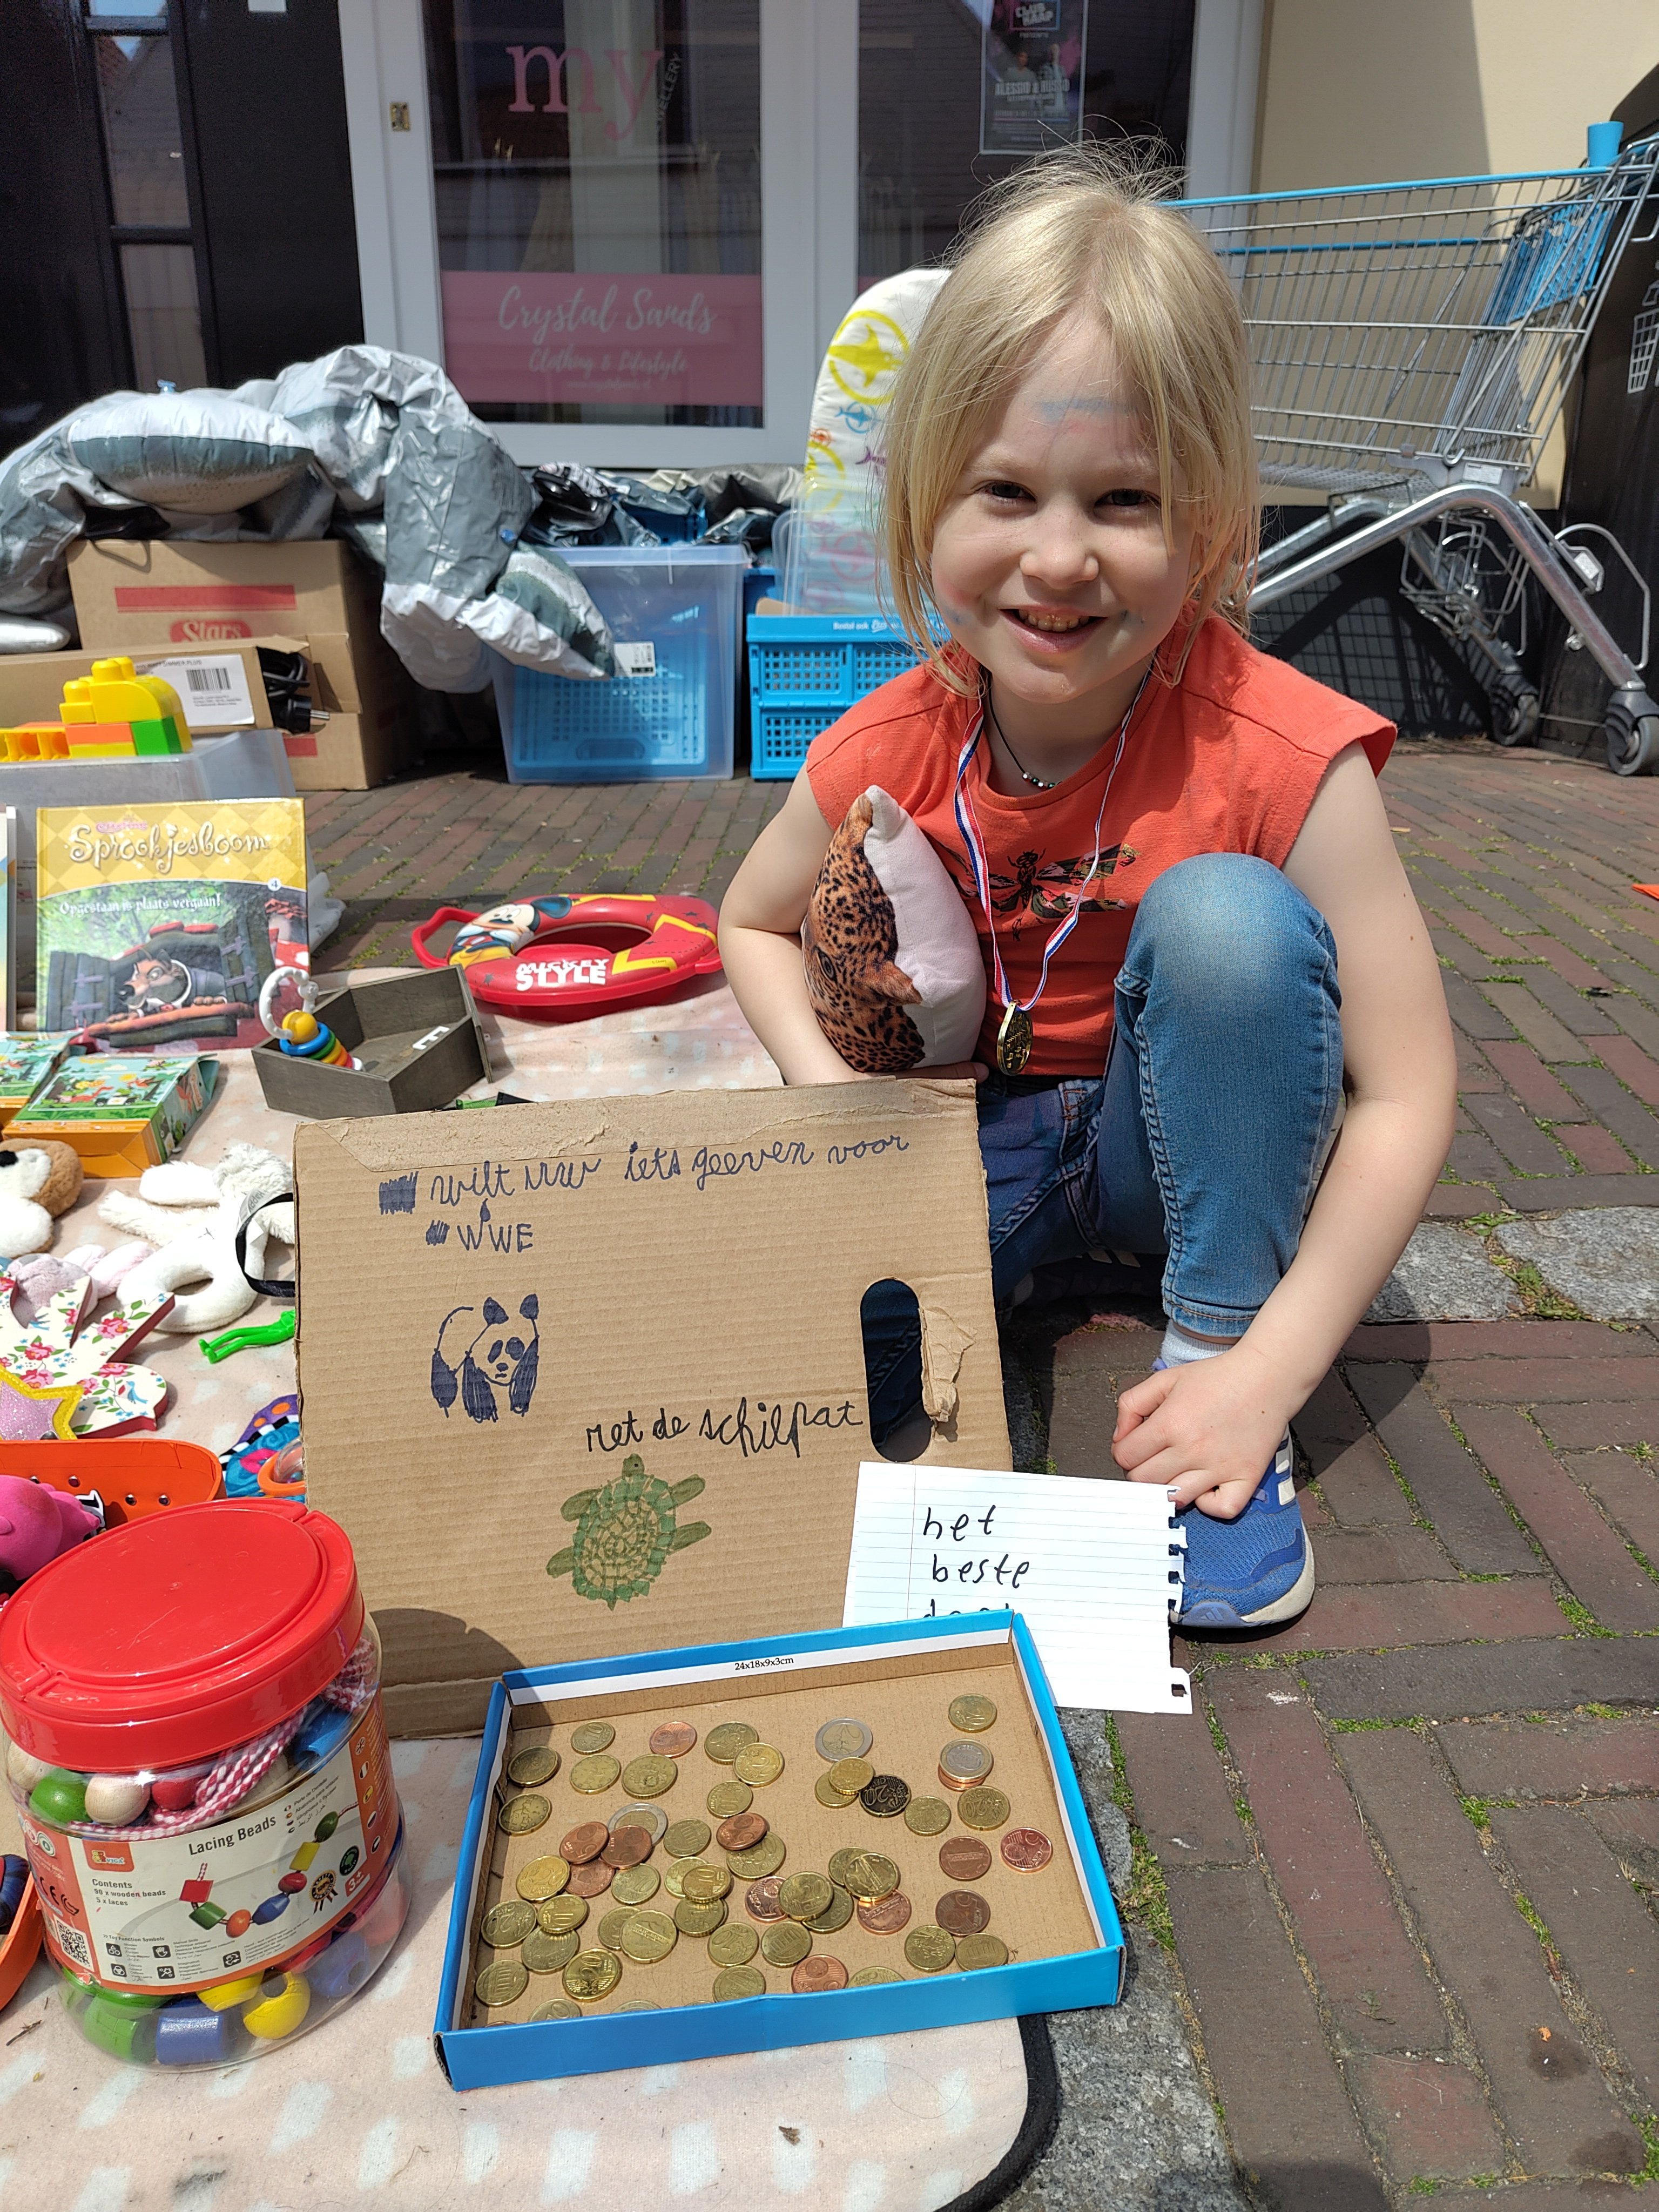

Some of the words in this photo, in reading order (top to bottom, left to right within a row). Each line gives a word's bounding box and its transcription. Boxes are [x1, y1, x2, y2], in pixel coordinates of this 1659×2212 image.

[505, 45, 664, 141] my
[499, 284, 618, 345] Crystal
[626, 287, 718, 335] Sands
[69, 820, 268, 875] Sprookjesboom
[271, 880, 278, 889] 4
[59, 901, 119, 918] Opgestaan
[122, 901, 133, 912] is
[135, 895, 169, 913] plaats
[172, 893, 222, 911] vergaan!
[516, 958, 609, 974] MICKEY
[516, 965, 606, 992] STYLE
[430, 1159, 515, 1207] wilt
[624, 1141, 681, 1182] iets
[828, 1135, 910, 1164] voor
[652, 1407, 691, 1440] de
[923, 1505, 996, 1542] het
[932, 1553, 1030, 1589] beste
[734, 1657, 794, 1670] 24x18x9x3cm
[864, 1784, 890, 1806] 20
[964, 1797, 988, 1819] 20
[189, 1834, 235, 1856] Lacing
[237, 1816, 276, 1841] Beads
[92, 1878, 133, 1889] Contents
[636, 1877, 656, 1892] 10
